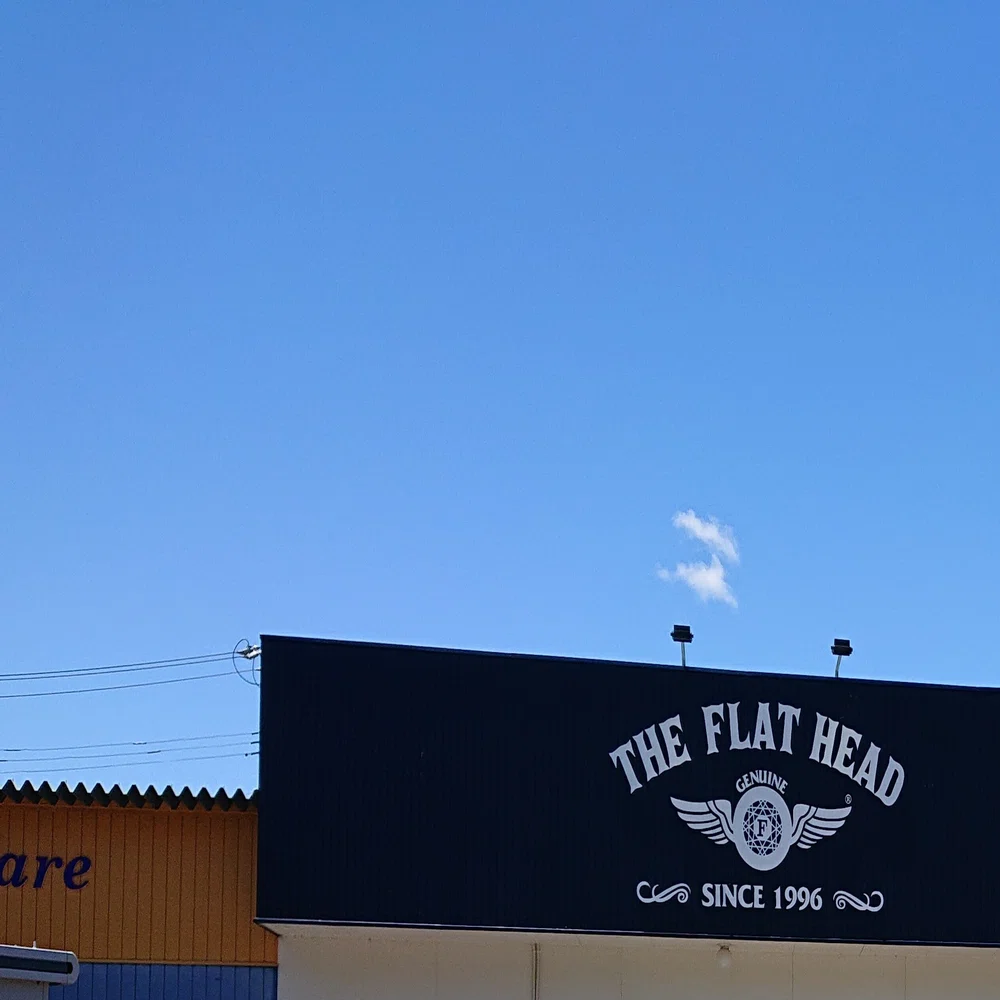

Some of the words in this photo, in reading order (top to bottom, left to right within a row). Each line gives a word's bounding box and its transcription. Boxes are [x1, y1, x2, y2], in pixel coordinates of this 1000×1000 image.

[609, 714, 692, 794] THE
[701, 701, 801, 755] FLAT
[809, 712, 905, 807] HEAD
[735, 769, 789, 794] GENUINE
[757, 819, 768, 837] F
[701, 883, 765, 909] SINCE
[774, 886, 823, 911] 1996
